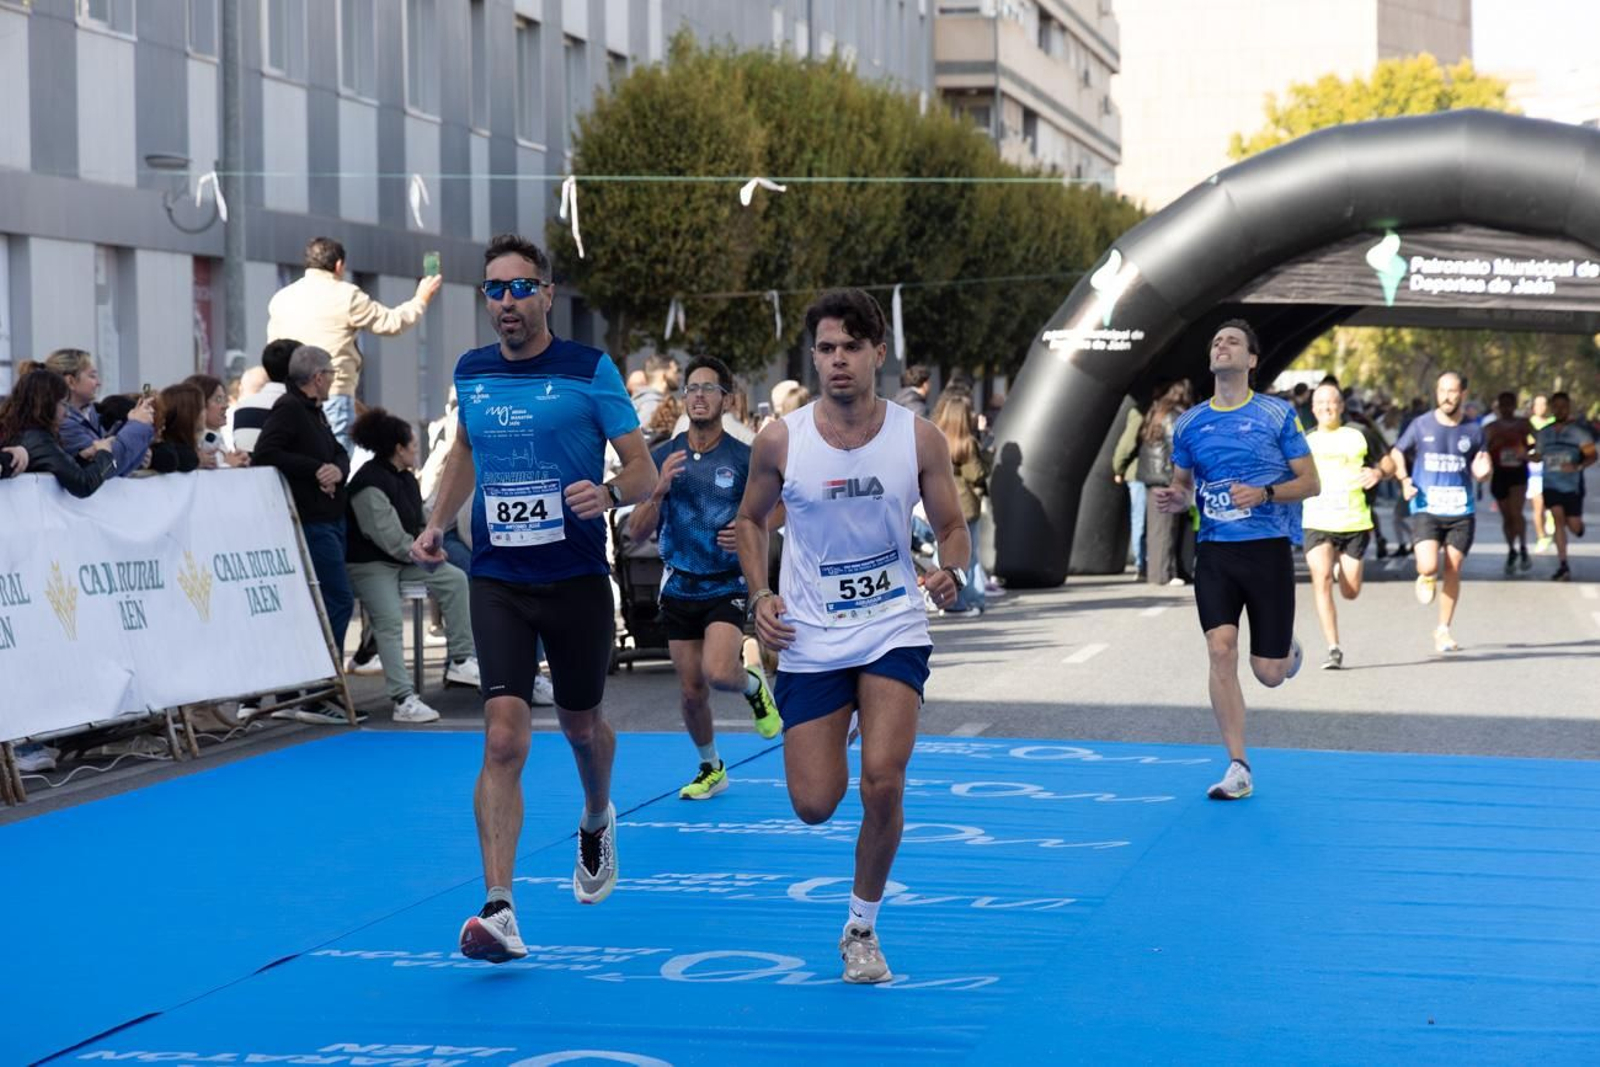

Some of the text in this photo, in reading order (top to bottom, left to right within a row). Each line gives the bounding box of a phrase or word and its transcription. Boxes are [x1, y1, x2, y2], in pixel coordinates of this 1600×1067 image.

[1409, 256, 1600, 279] Patronato Municipal de
[1409, 274, 1486, 294] Deportes
[1487, 277, 1511, 293] de
[823, 476, 884, 499] FILA
[496, 499, 548, 522] 824
[115, 559, 165, 592] RURAL
[213, 547, 296, 582] CAJA RURAL
[839, 570, 891, 600] 534
